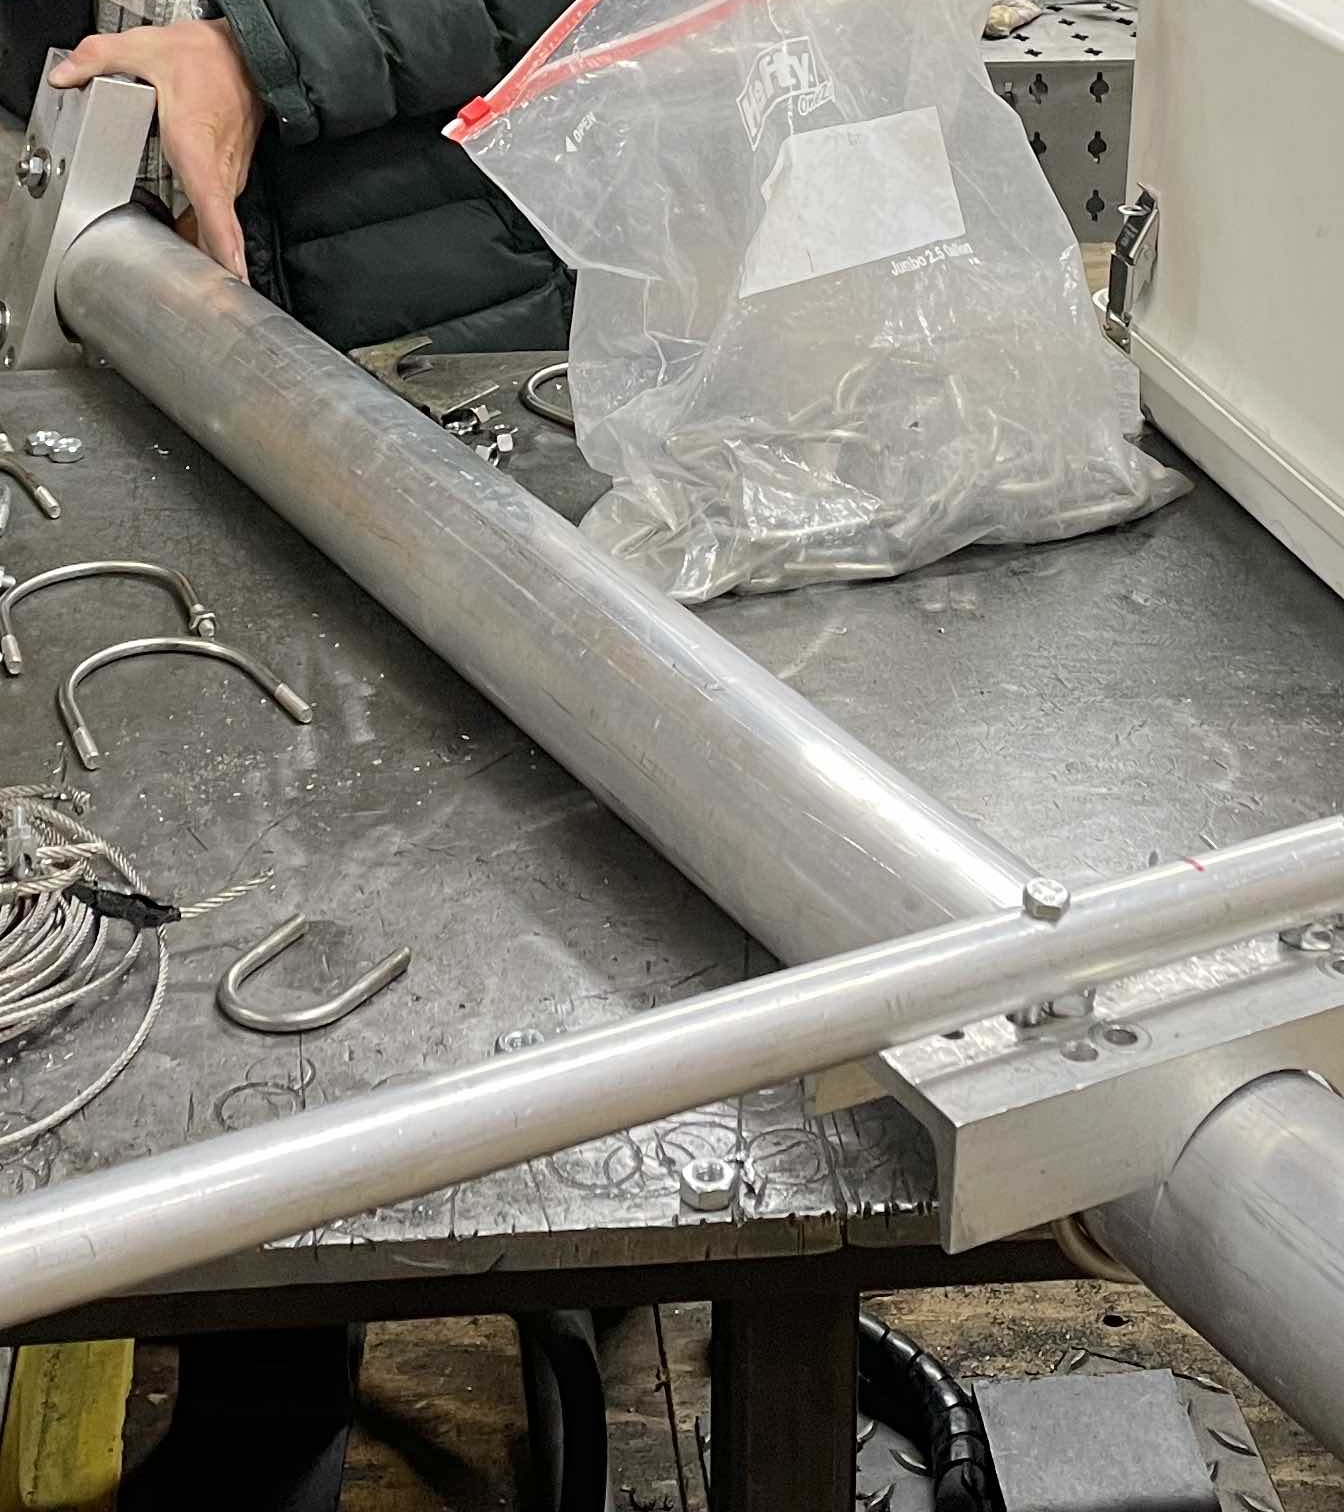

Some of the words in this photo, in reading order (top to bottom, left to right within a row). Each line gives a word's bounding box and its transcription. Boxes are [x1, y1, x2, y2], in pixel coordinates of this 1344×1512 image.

[741, 52, 809, 137] Hefty
[573, 111, 597, 144] OPEN
[891, 256, 928, 276] Jumbo
